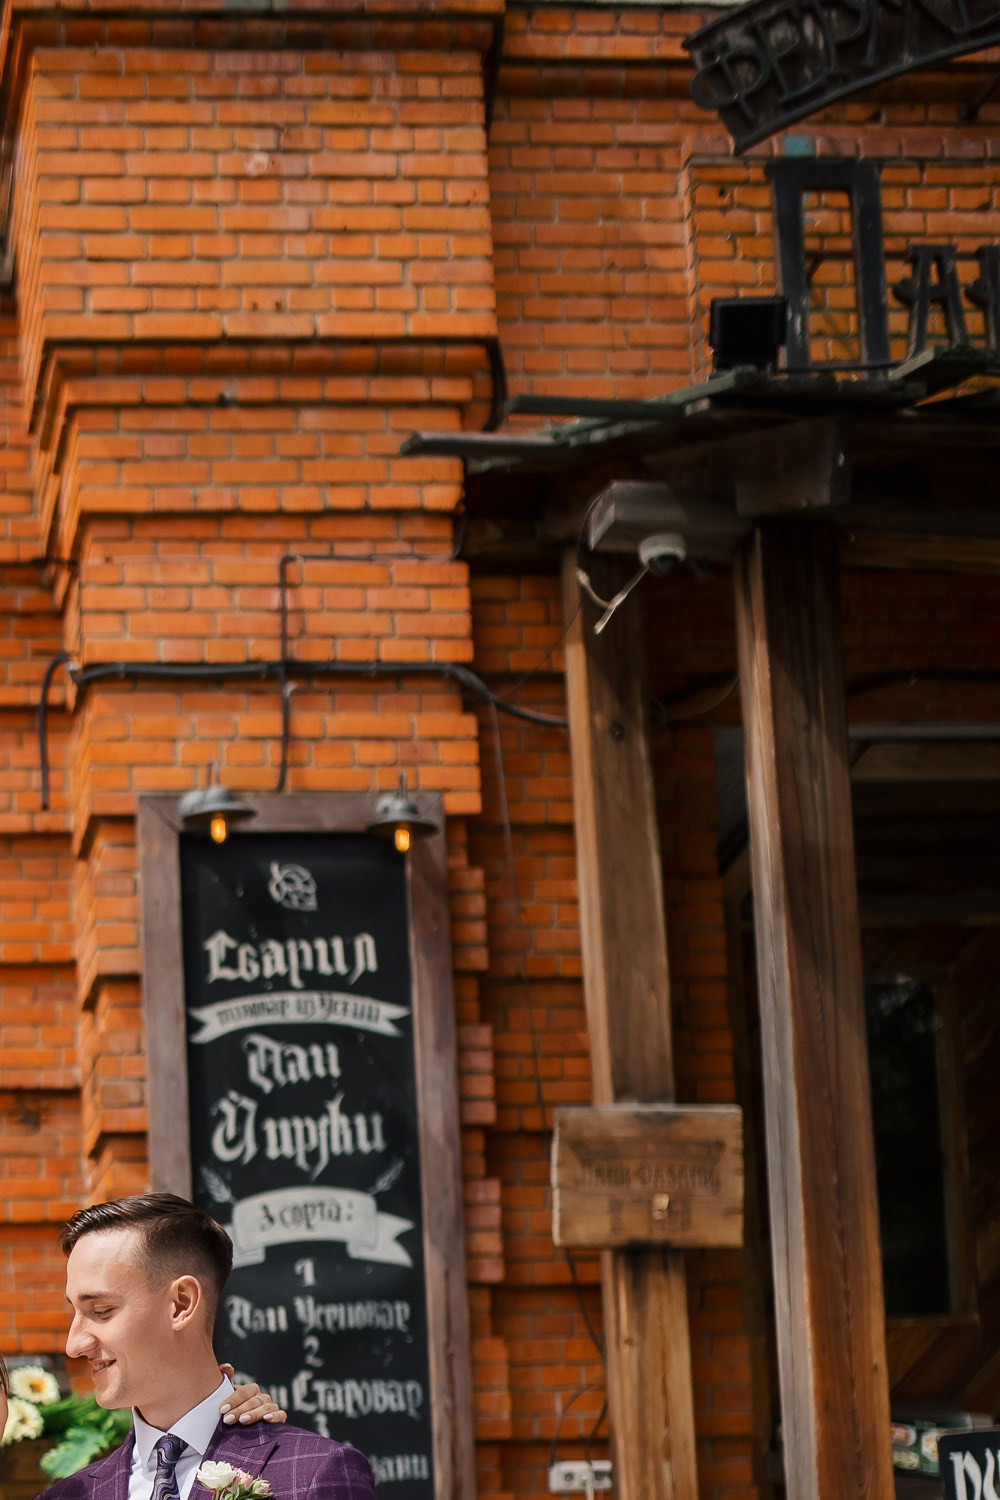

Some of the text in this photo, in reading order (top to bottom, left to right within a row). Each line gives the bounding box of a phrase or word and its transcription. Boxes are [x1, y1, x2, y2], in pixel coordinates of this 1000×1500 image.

[203, 929, 379, 989] Сварил
[243, 1033, 341, 1094] Пан
[259, 1200, 354, 1231] 3 сорта:
[294, 1258, 316, 1287] 1
[226, 1295, 289, 1340] Пан
[302, 1335, 325, 1368] 2
[290, 1370, 425, 1421] Старовар
